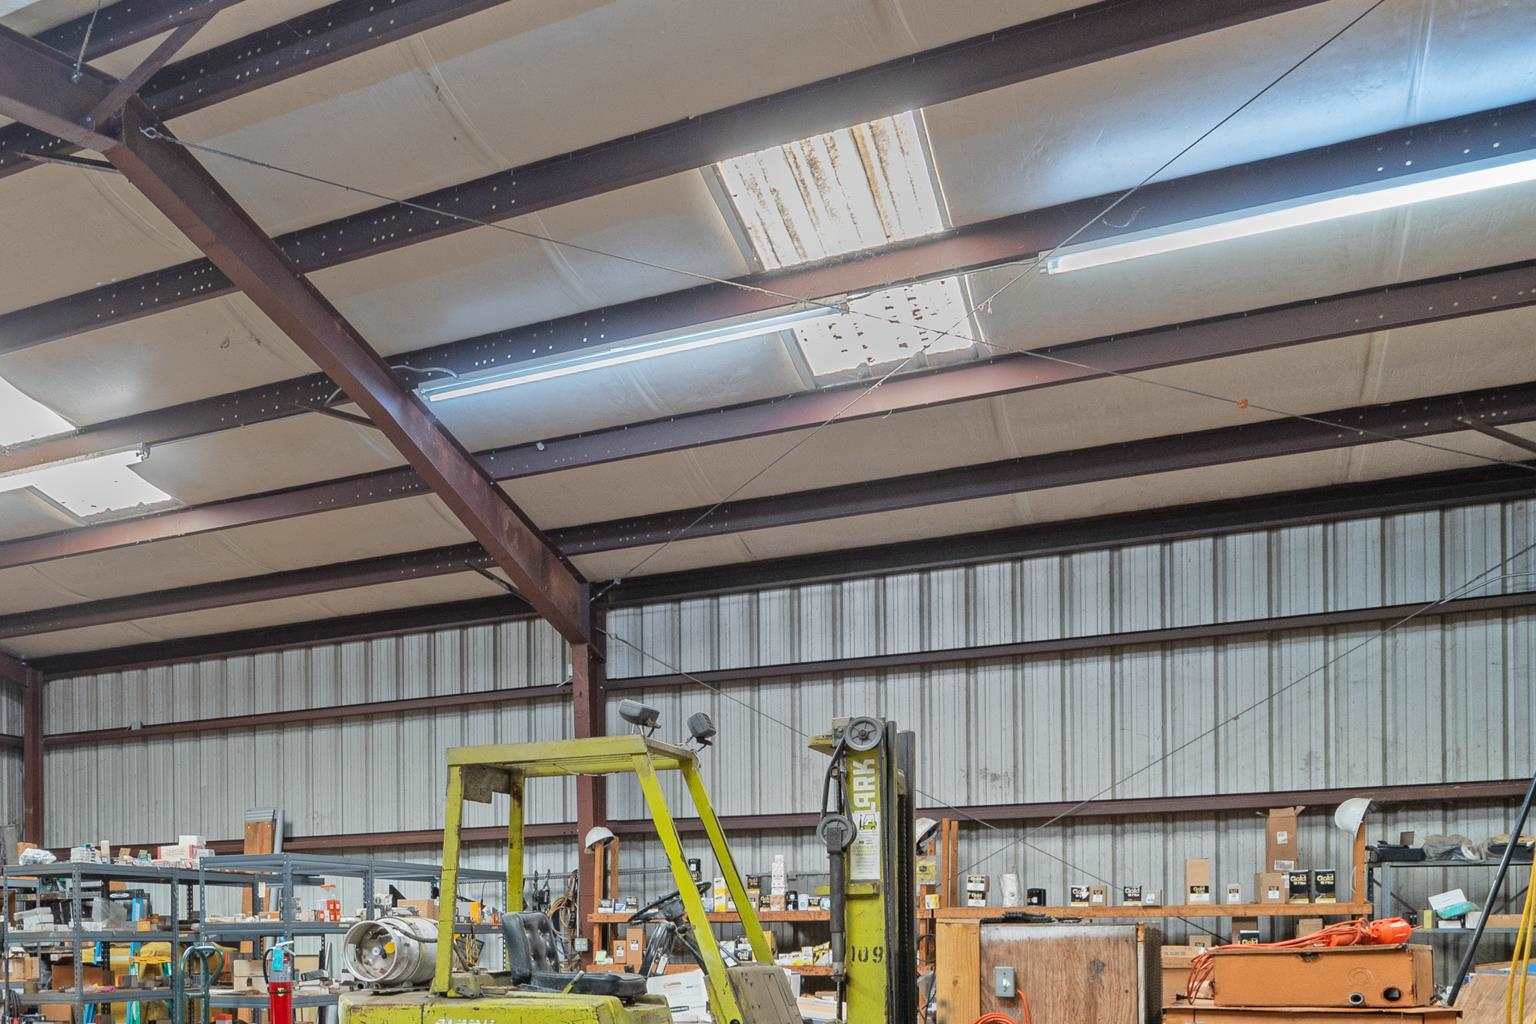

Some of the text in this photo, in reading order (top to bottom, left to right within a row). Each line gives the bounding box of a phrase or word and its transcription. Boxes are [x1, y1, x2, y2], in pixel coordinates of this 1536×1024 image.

[853, 758, 876, 813] ARK
[1290, 874, 1307, 882] Gold
[1316, 874, 1334, 882] Gold
[850, 945, 884, 964] 109
